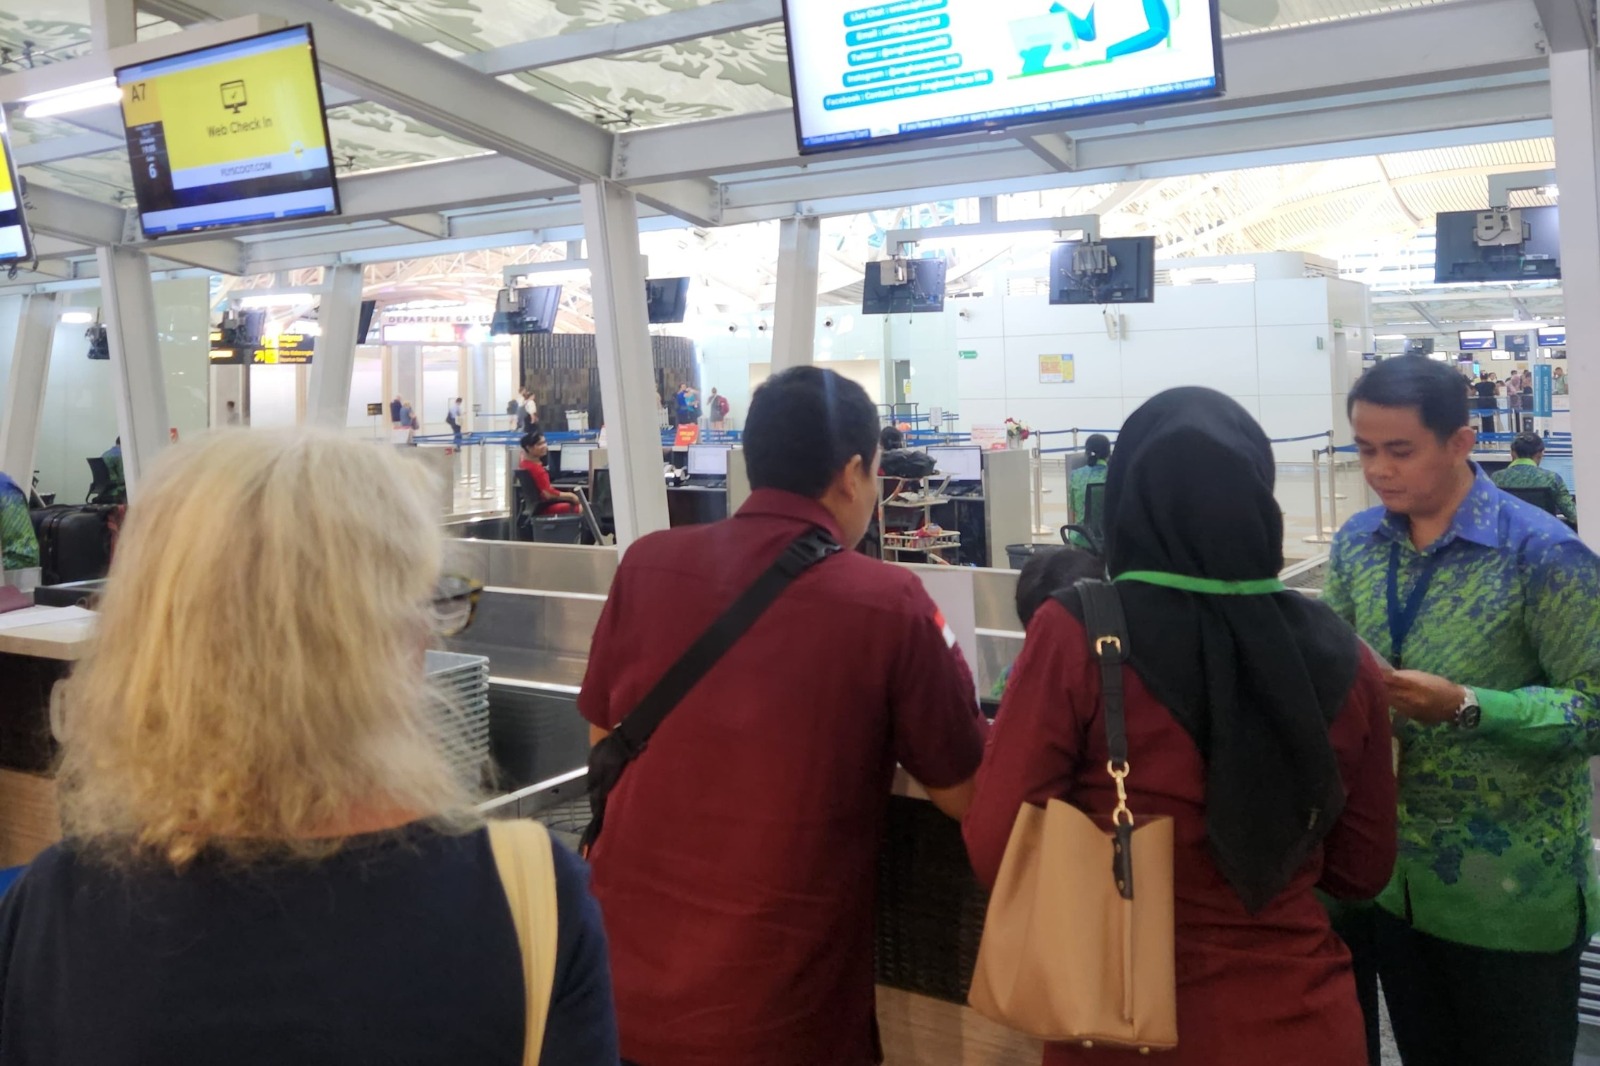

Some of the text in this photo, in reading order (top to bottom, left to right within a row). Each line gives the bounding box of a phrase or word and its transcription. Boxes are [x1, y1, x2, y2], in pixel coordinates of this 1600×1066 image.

[131, 82, 146, 103] A7
[826, 94, 861, 106] Facebook
[864, 88, 894, 100] Contact
[895, 85, 920, 96] Center
[207, 116, 273, 138] Web Check In
[148, 162, 158, 179] 6
[388, 315, 451, 323] DEPARTURE
